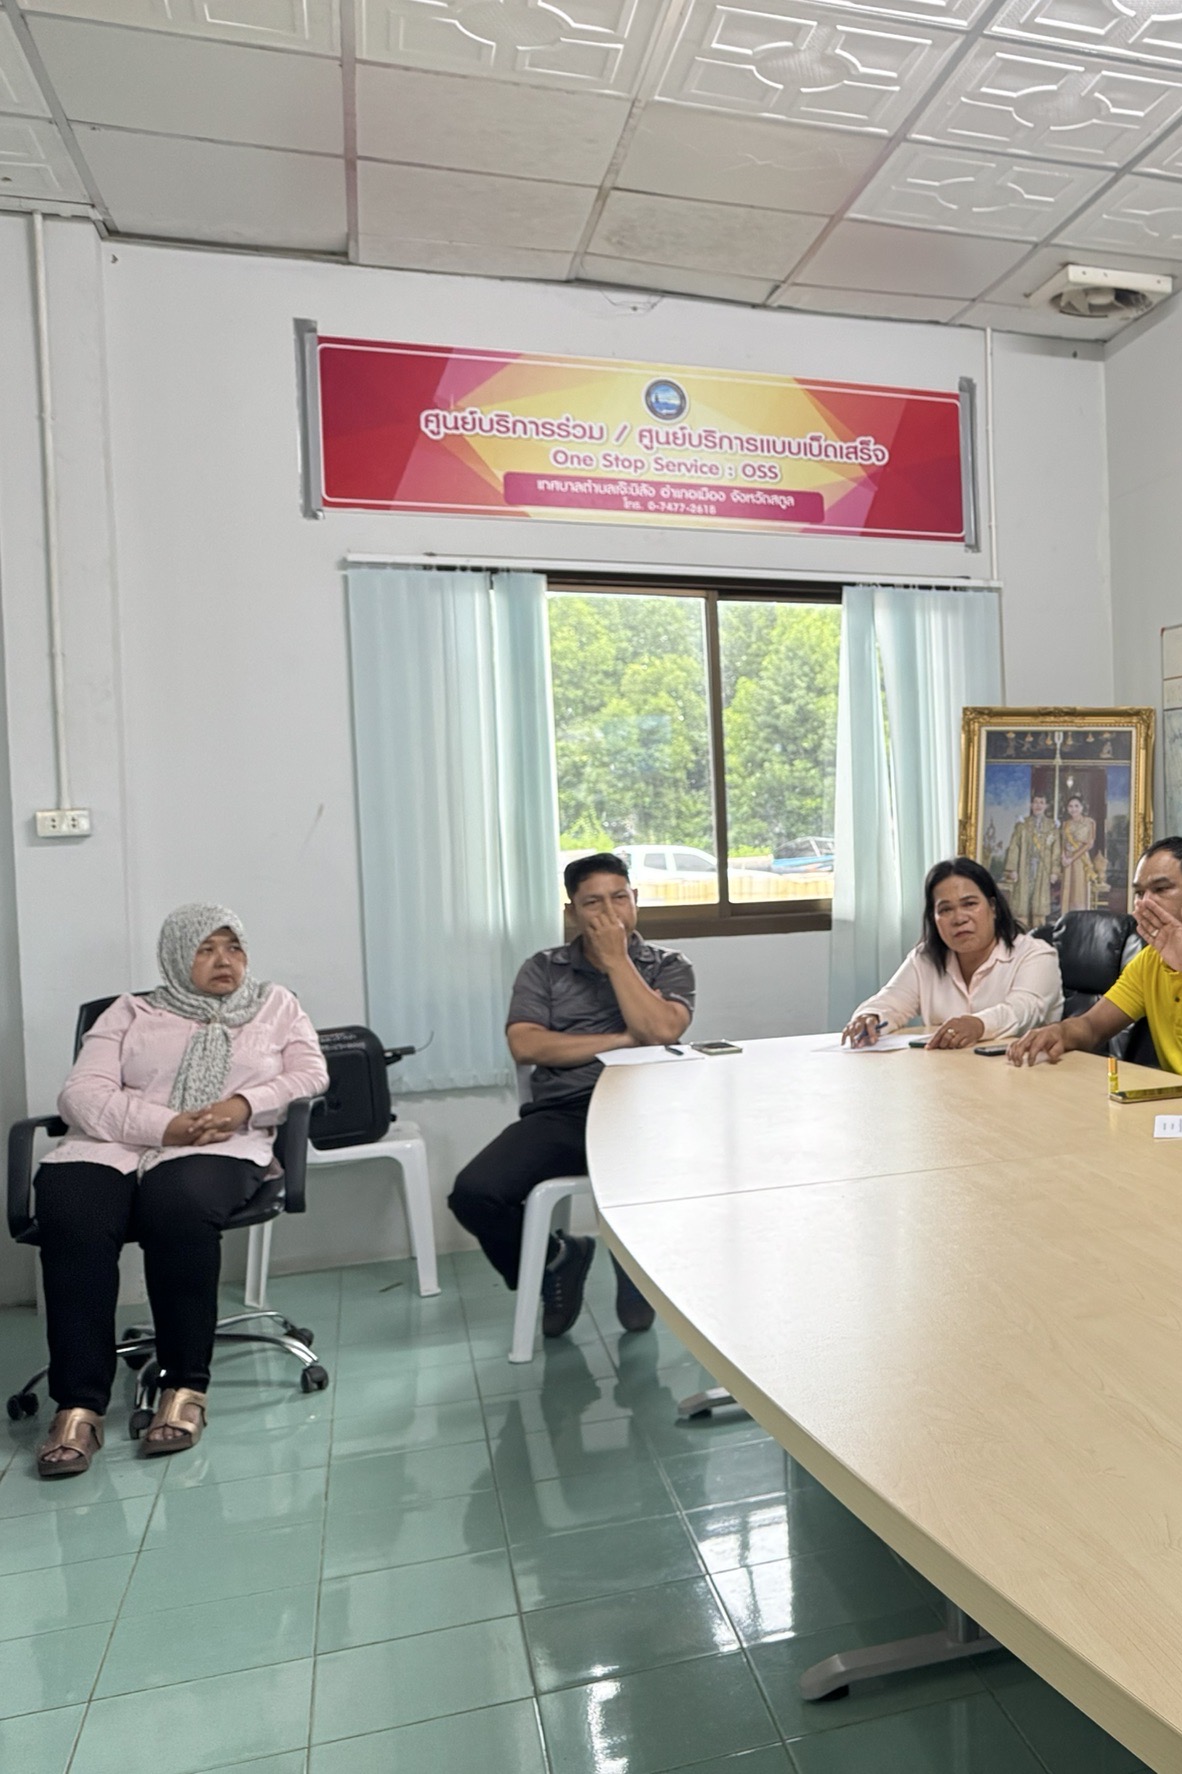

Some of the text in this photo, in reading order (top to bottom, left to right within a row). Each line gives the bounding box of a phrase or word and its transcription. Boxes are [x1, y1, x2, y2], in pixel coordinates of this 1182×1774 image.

[424, 410, 887, 463] ศูนย์บริการร่วม / ศูนย์บริการแบบเบ็ดเสร็จ
[552, 449, 594, 468] One
[601, 452, 646, 475] Stop
[653, 456, 720, 477] Service
[741, 463, 779, 482] OSS
